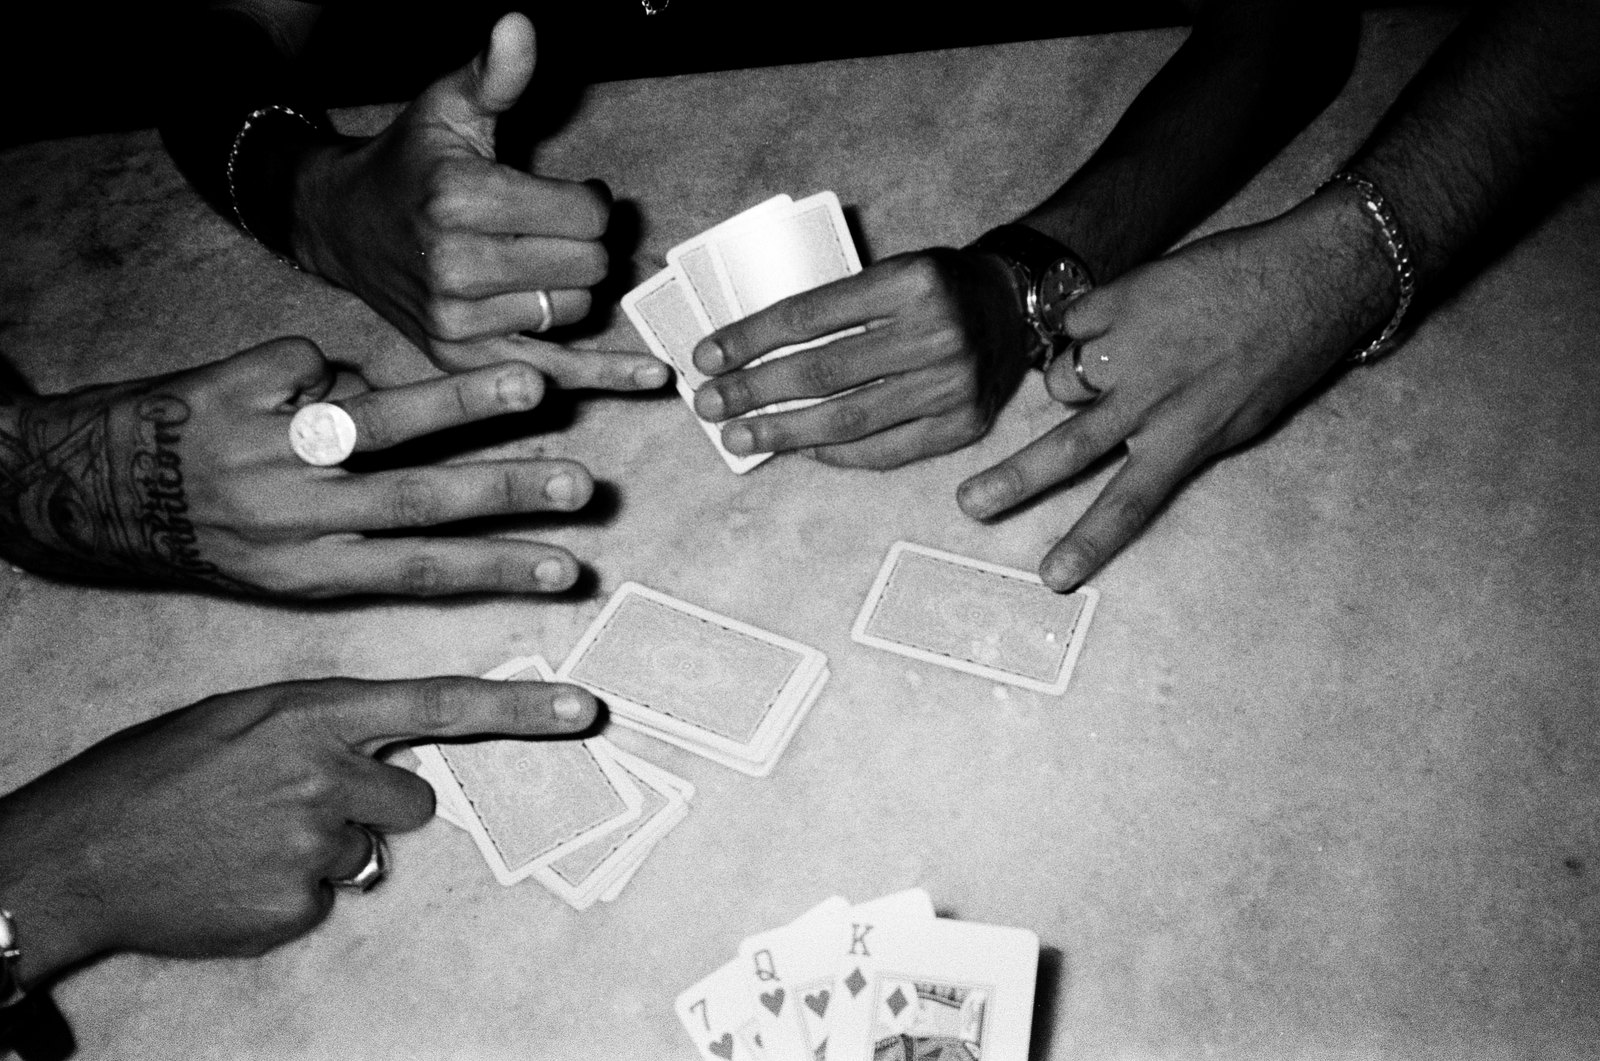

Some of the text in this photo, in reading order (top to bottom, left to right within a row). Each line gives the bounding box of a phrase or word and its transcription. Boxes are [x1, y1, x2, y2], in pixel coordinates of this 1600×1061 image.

[849, 923, 874, 957] K
[754, 949, 781, 982] Q
[689, 998, 711, 1032] 7
